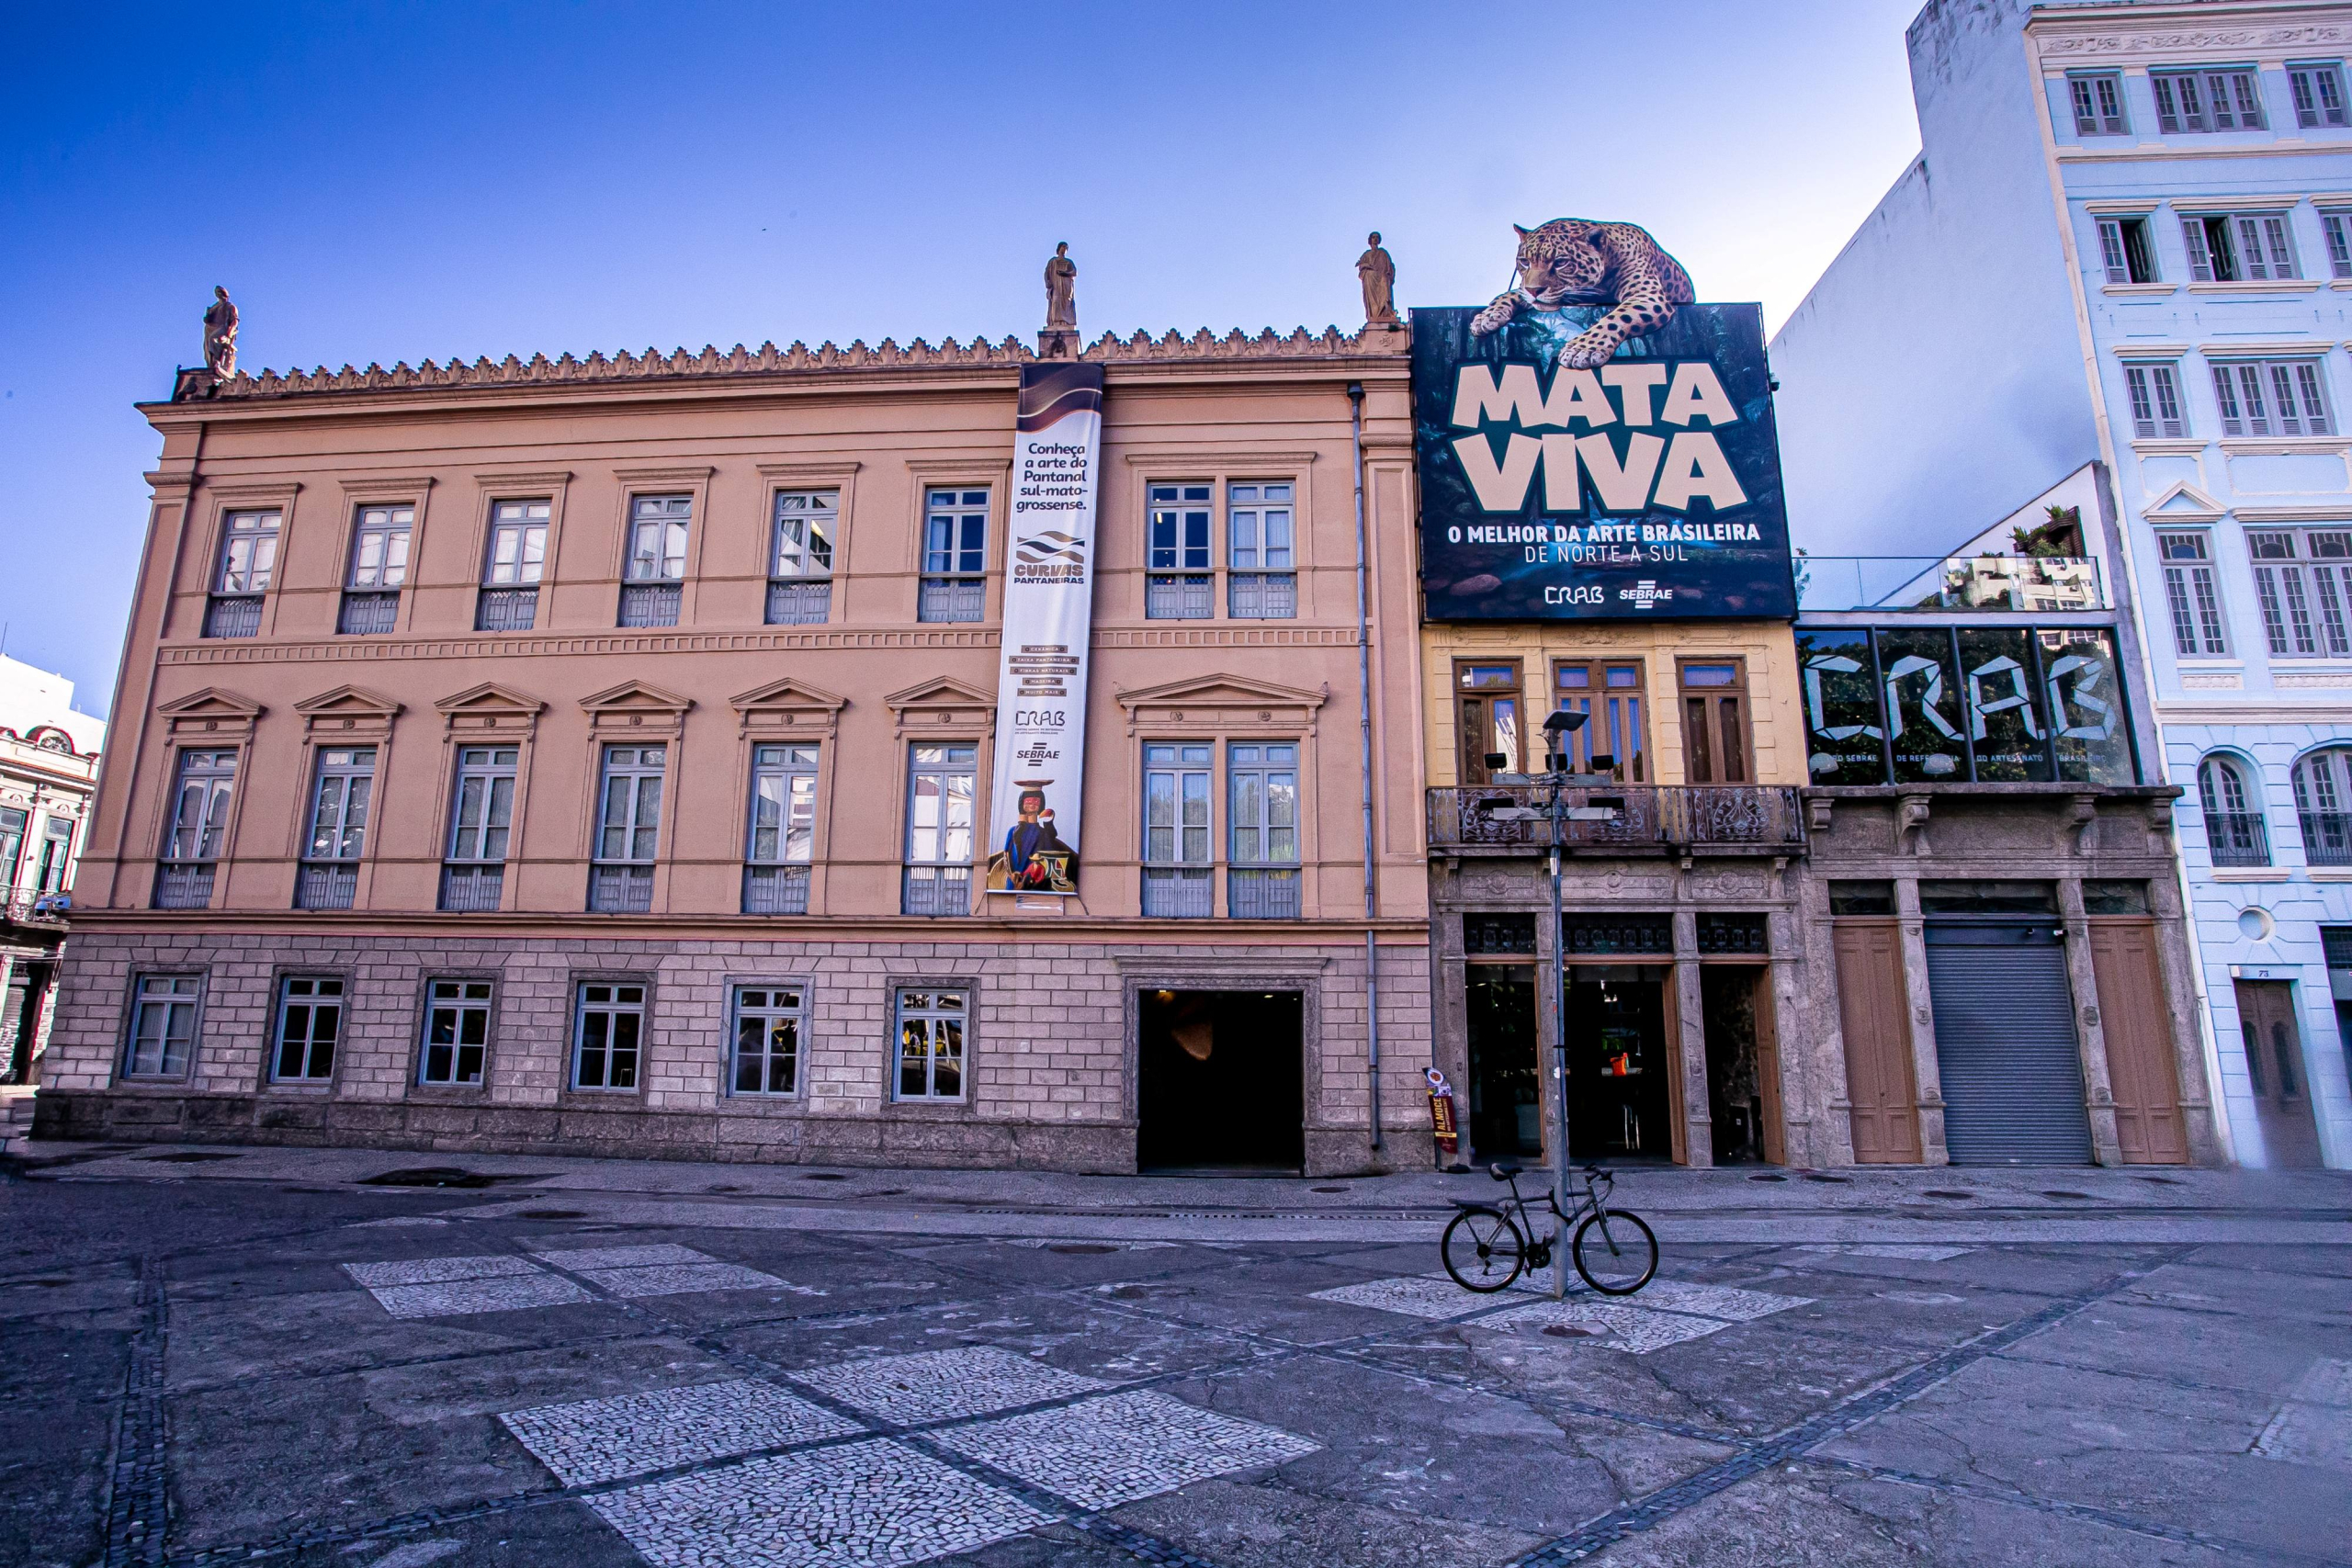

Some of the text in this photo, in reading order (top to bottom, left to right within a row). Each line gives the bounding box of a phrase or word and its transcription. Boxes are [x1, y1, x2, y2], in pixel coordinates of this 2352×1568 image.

[1452, 362, 1738, 428] MATA
[1028, 443, 1085, 457] Conheça
[1024, 457, 1087, 468] a arte do
[1023, 469, 1087, 482] Pantanal
[1453, 432, 1747, 511] VIVA
[1020, 484, 1088, 496] sul-mato-
[1016, 501, 1087, 513] grossense.
[1448, 524, 1760, 543] O MELHOR DA ARTE BRASILEIRA
[1525, 545, 1688, 562] DE NORTE A SUL
[1014, 564, 1084, 577] CURVAS
[1544, 586, 1604, 604] CRAB
[1619, 590, 1673, 600] SEBRAE
[1804, 655, 2116, 740] CRAB
[1015, 711, 1066, 727] CRAB
[1017, 750, 1060, 759] SEBRAE
